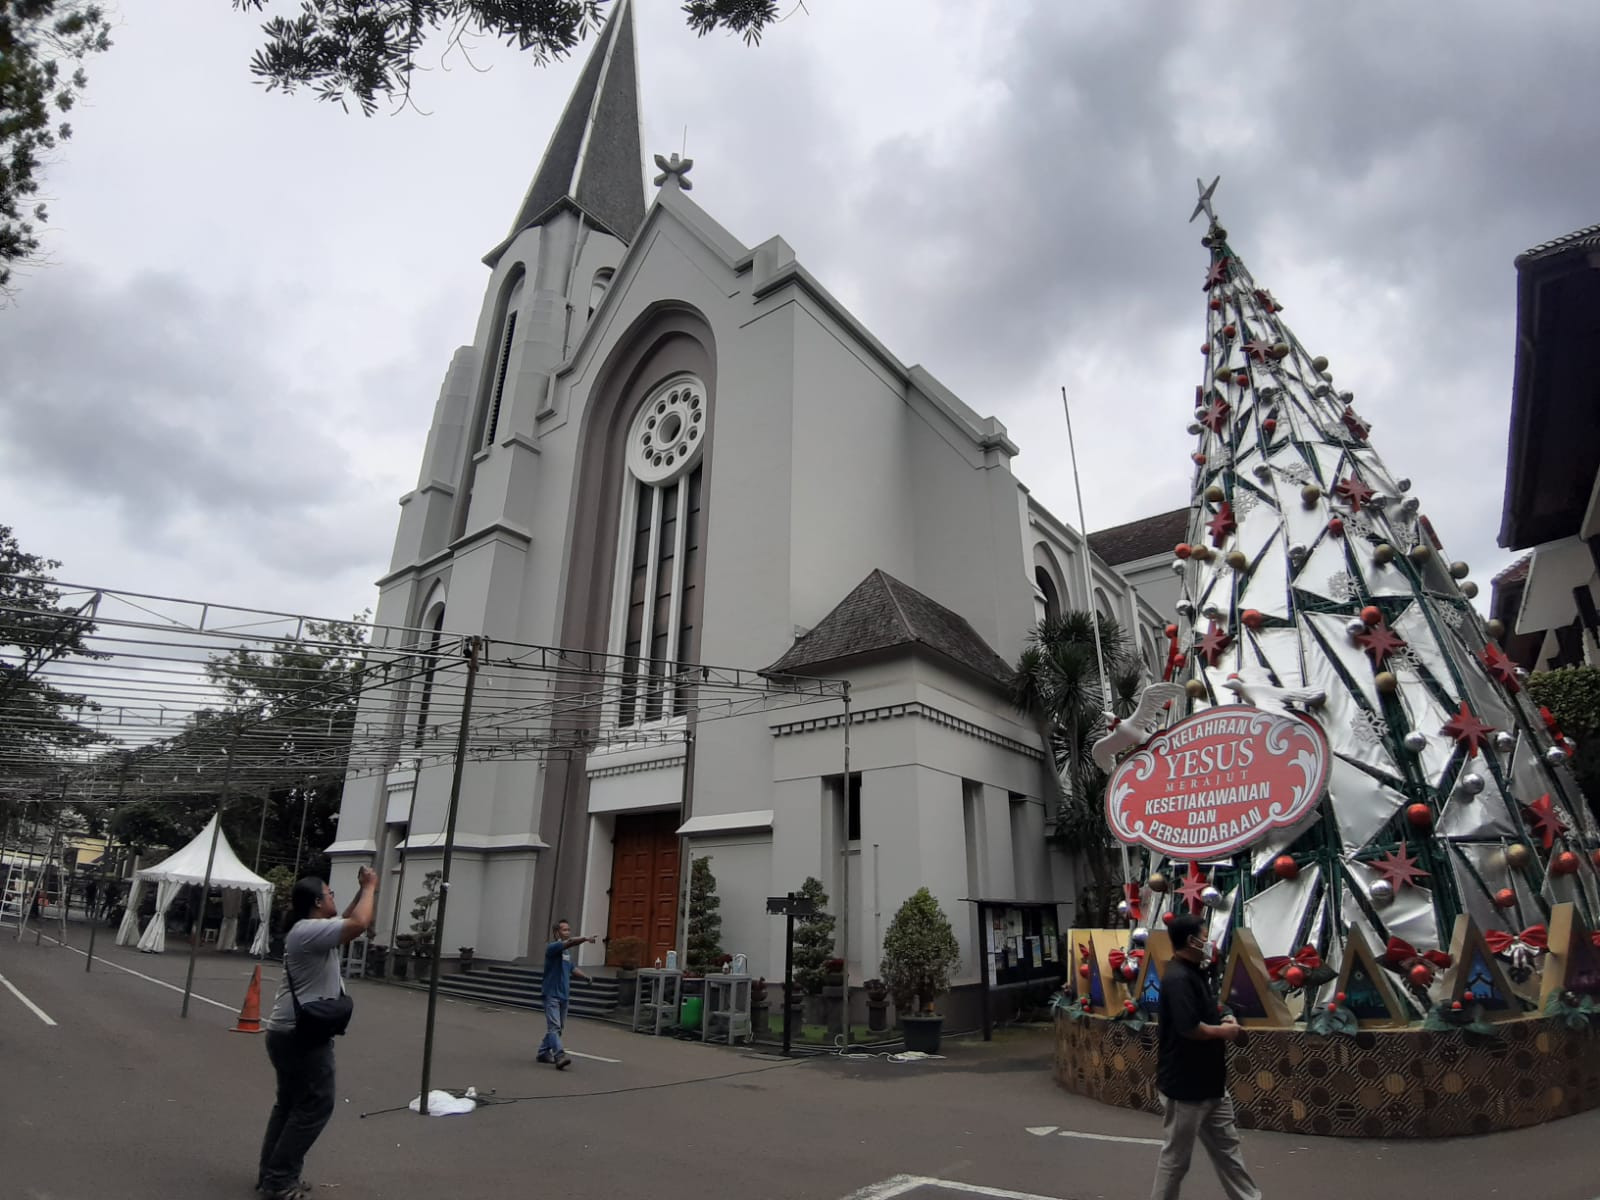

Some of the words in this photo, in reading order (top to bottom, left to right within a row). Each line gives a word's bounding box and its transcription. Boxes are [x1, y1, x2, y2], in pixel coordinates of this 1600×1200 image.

[1172, 719, 1248, 749] KELAHIRAN
[1166, 738, 1254, 780] YESUS
[1165, 770, 1248, 792] MERAJUT
[1145, 781, 1270, 815] KESETIAKAWANAN
[1149, 807, 1262, 844] PERSAUDARAAN
[1188, 809, 1216, 826] DAN
